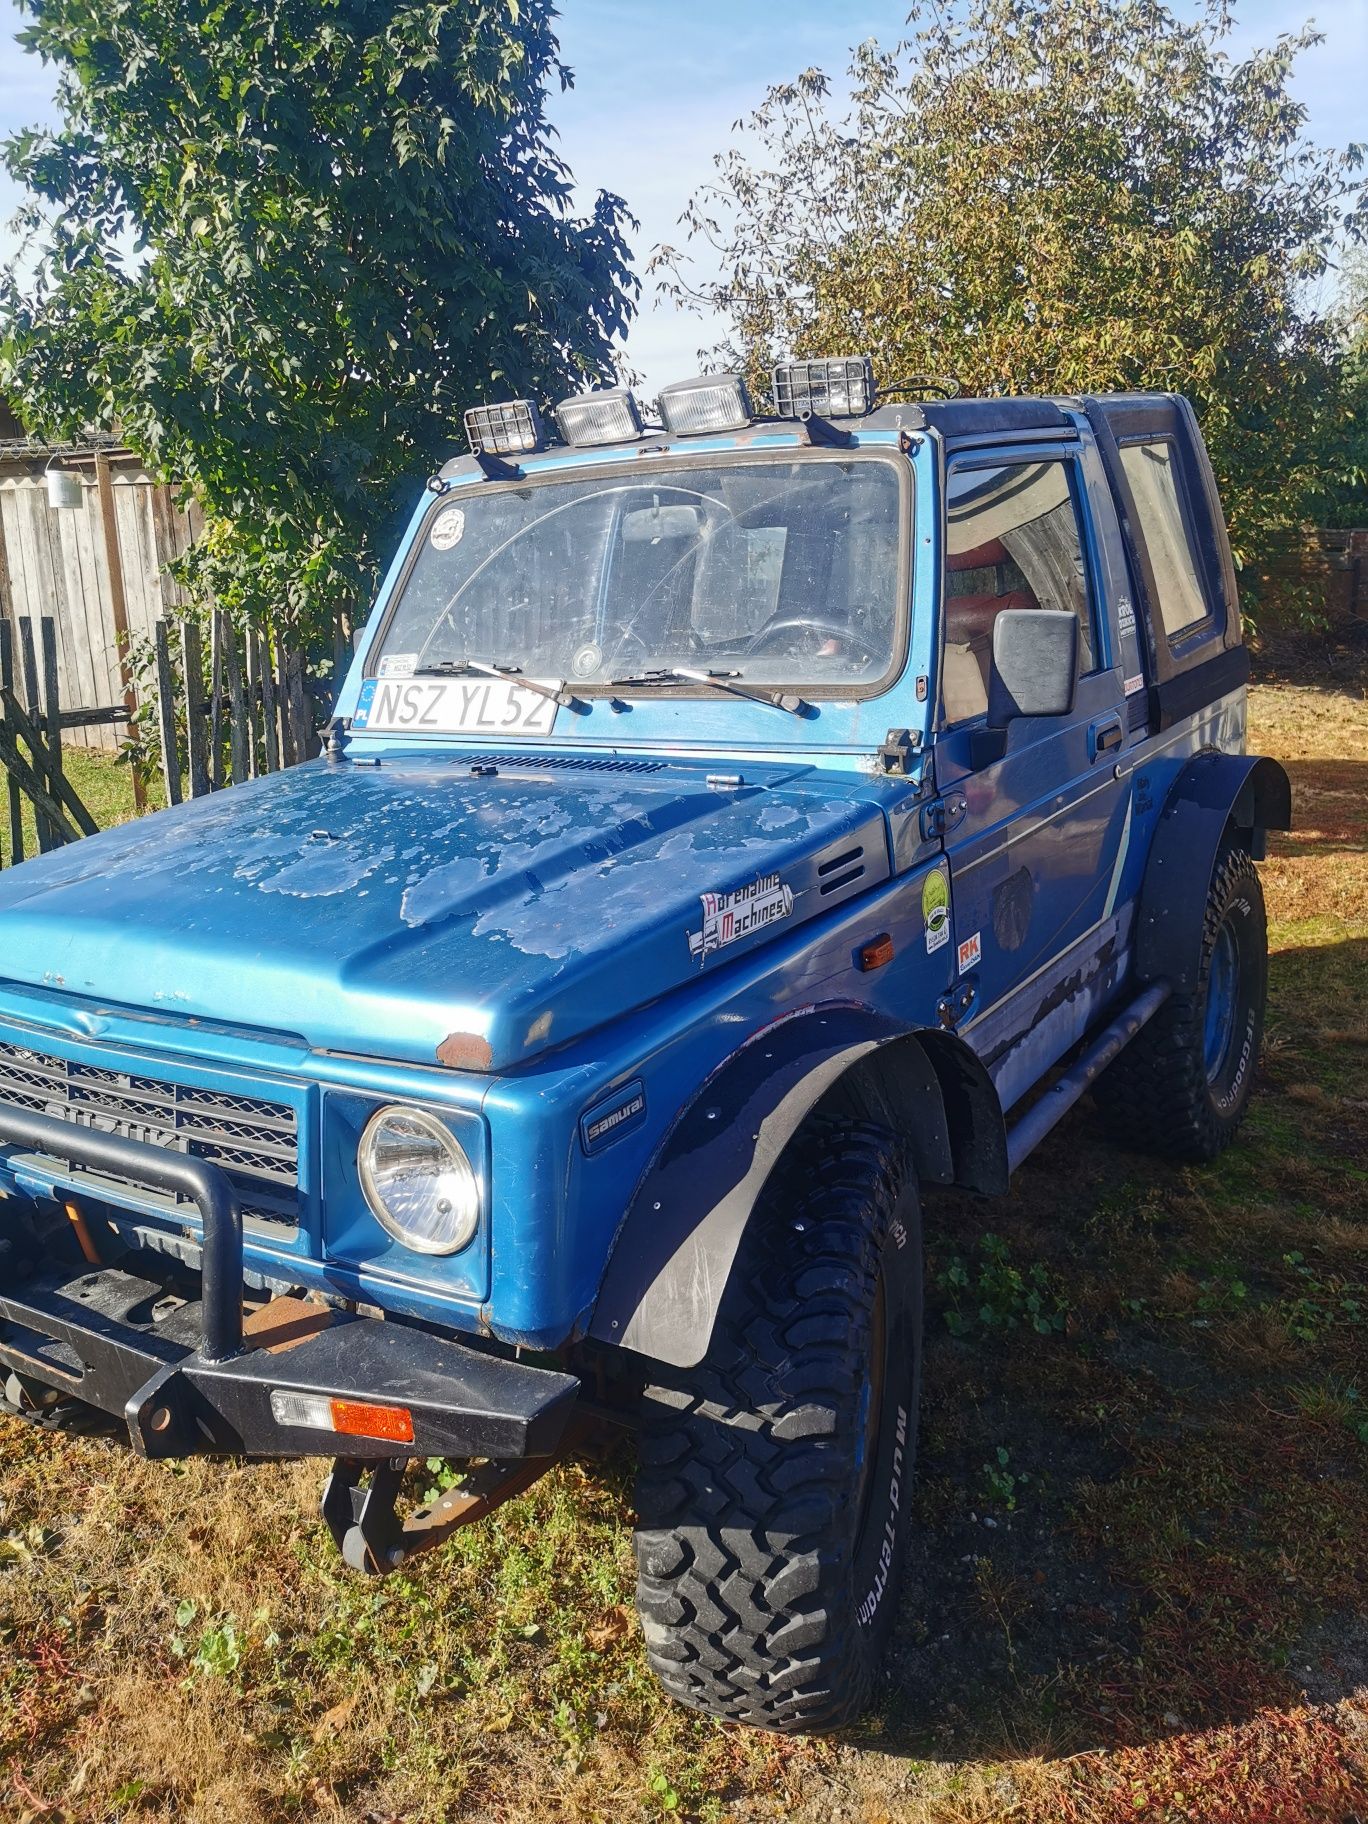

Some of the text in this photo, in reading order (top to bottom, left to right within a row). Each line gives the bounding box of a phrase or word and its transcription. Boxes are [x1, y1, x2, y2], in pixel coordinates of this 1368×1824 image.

[356, 709, 369, 721] PL
[375, 684, 550, 727] NSZ YL52
[705, 871, 780, 916] Adrenaline
[721, 899, 784, 940] Machines
[959, 936, 979, 964] RK
